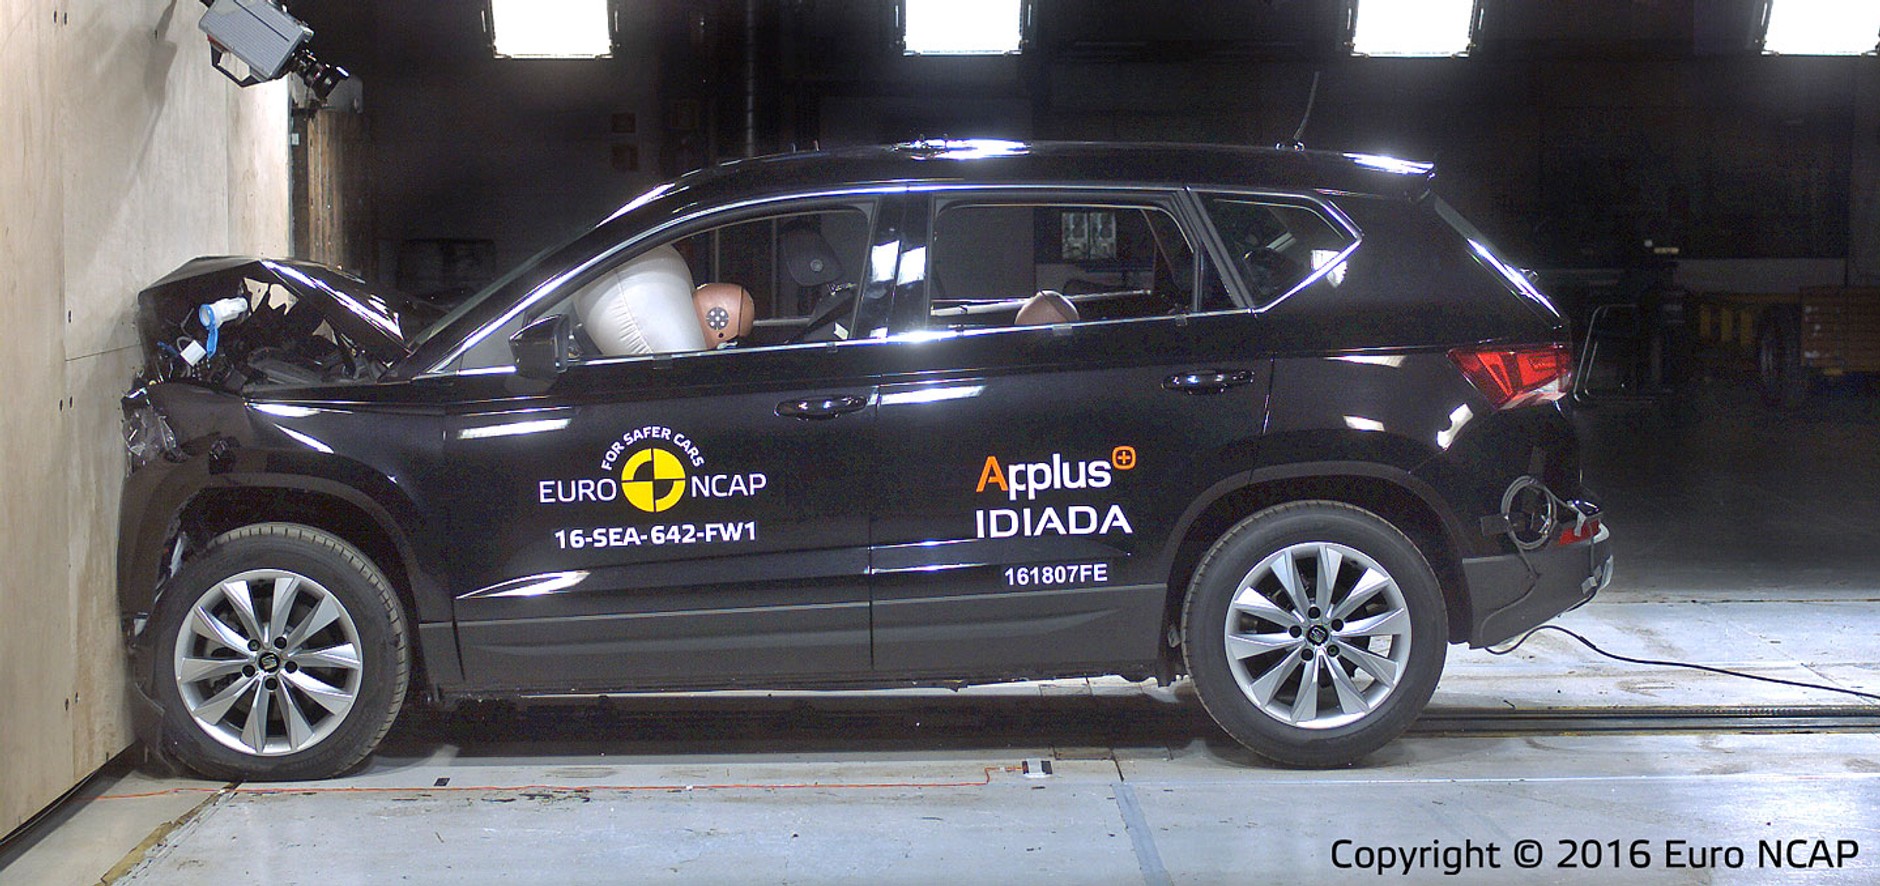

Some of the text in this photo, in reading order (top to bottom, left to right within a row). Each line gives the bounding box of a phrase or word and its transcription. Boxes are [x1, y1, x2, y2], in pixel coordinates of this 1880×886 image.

[601, 426, 705, 471] FOR SAFER CARS
[538, 472, 767, 503] EURO NCAP
[975, 504, 1133, 539] IDIADA
[1004, 563, 1108, 586] 161807FE
